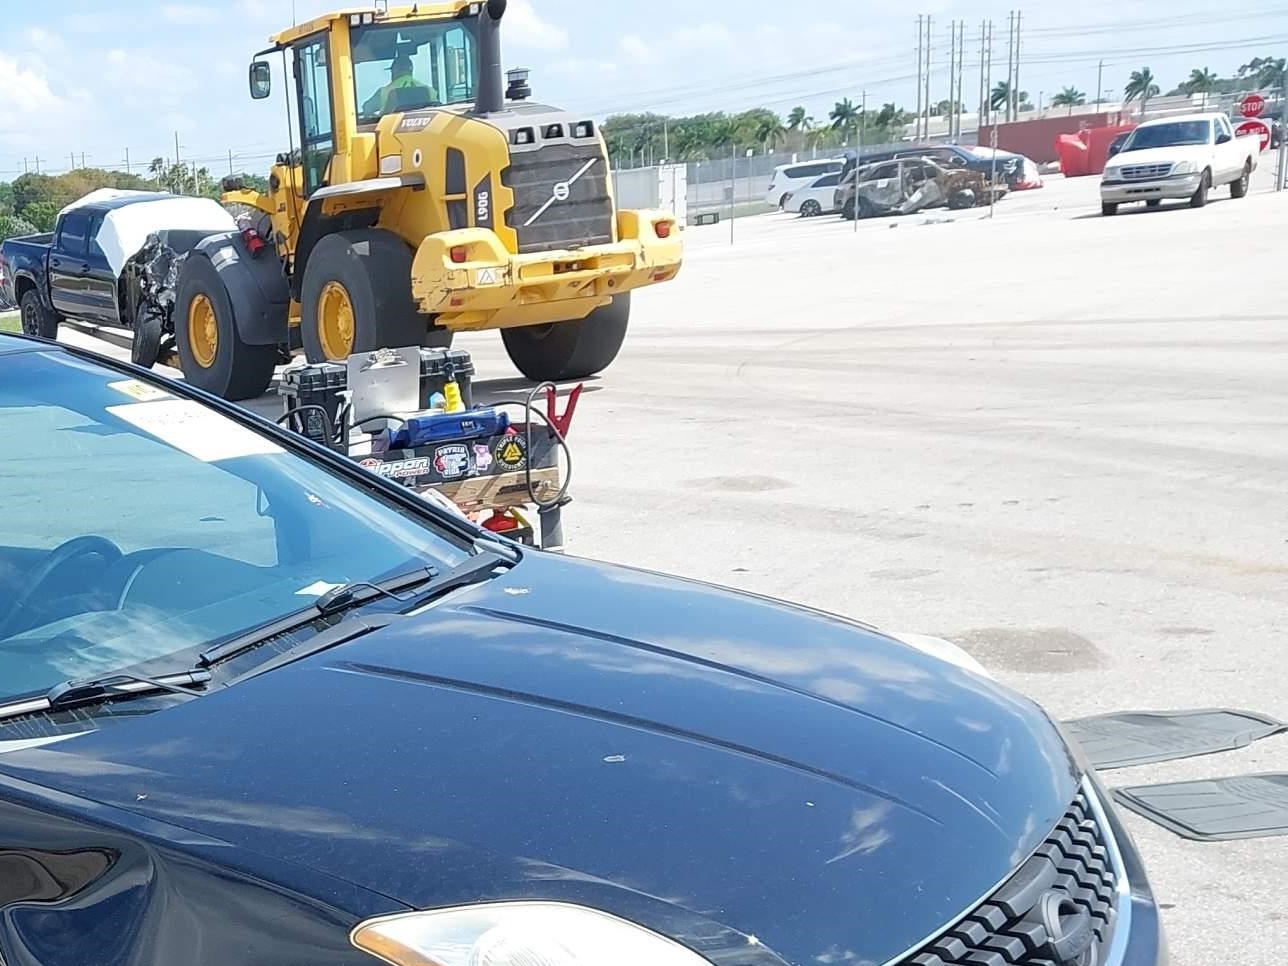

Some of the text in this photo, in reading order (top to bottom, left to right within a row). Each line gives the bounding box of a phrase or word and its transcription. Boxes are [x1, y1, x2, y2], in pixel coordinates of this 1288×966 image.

[1241, 101, 1263, 112] STOP
[401, 117, 431, 128] VOLVO
[478, 191, 489, 221] L90G
